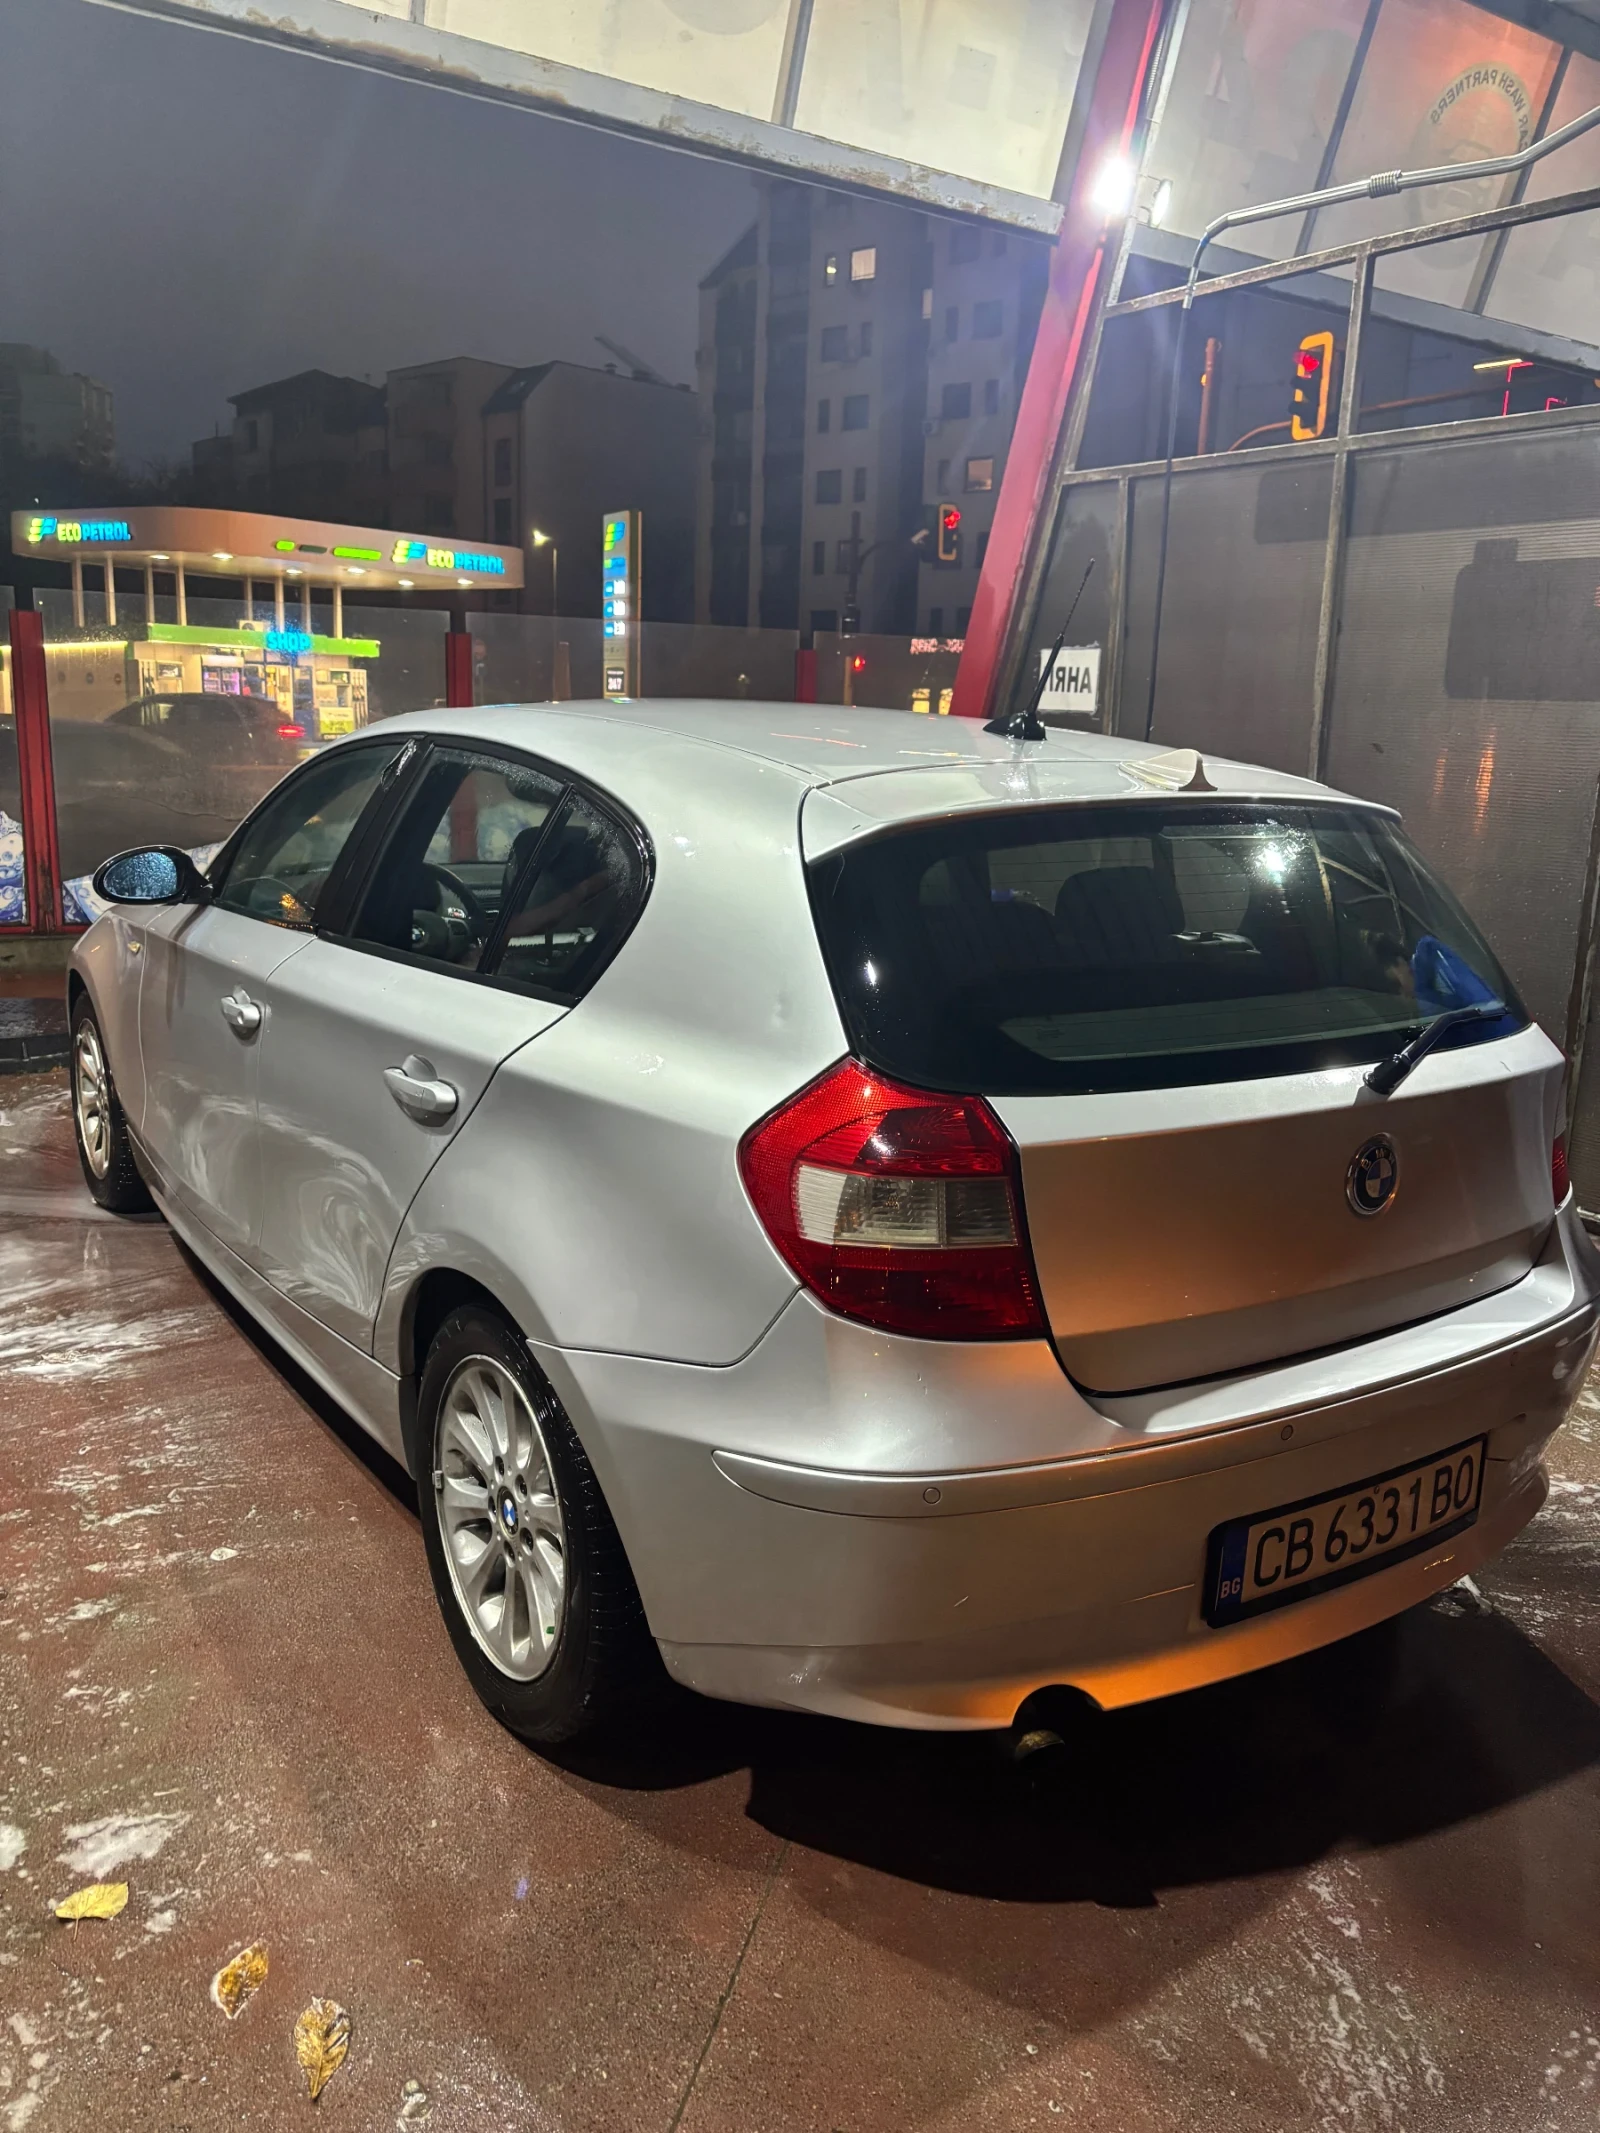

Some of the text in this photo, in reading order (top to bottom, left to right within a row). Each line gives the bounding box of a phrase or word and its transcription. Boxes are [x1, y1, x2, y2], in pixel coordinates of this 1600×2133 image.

[57, 522, 131, 541] ECOPETROL
[427, 549, 505, 575] ECOPETROL
[267, 632, 310, 652] SHOP
[1253, 1517, 1314, 1587] CB
[1324, 1477, 1422, 1563] 6331
[1220, 1577, 1241, 1599] BG
